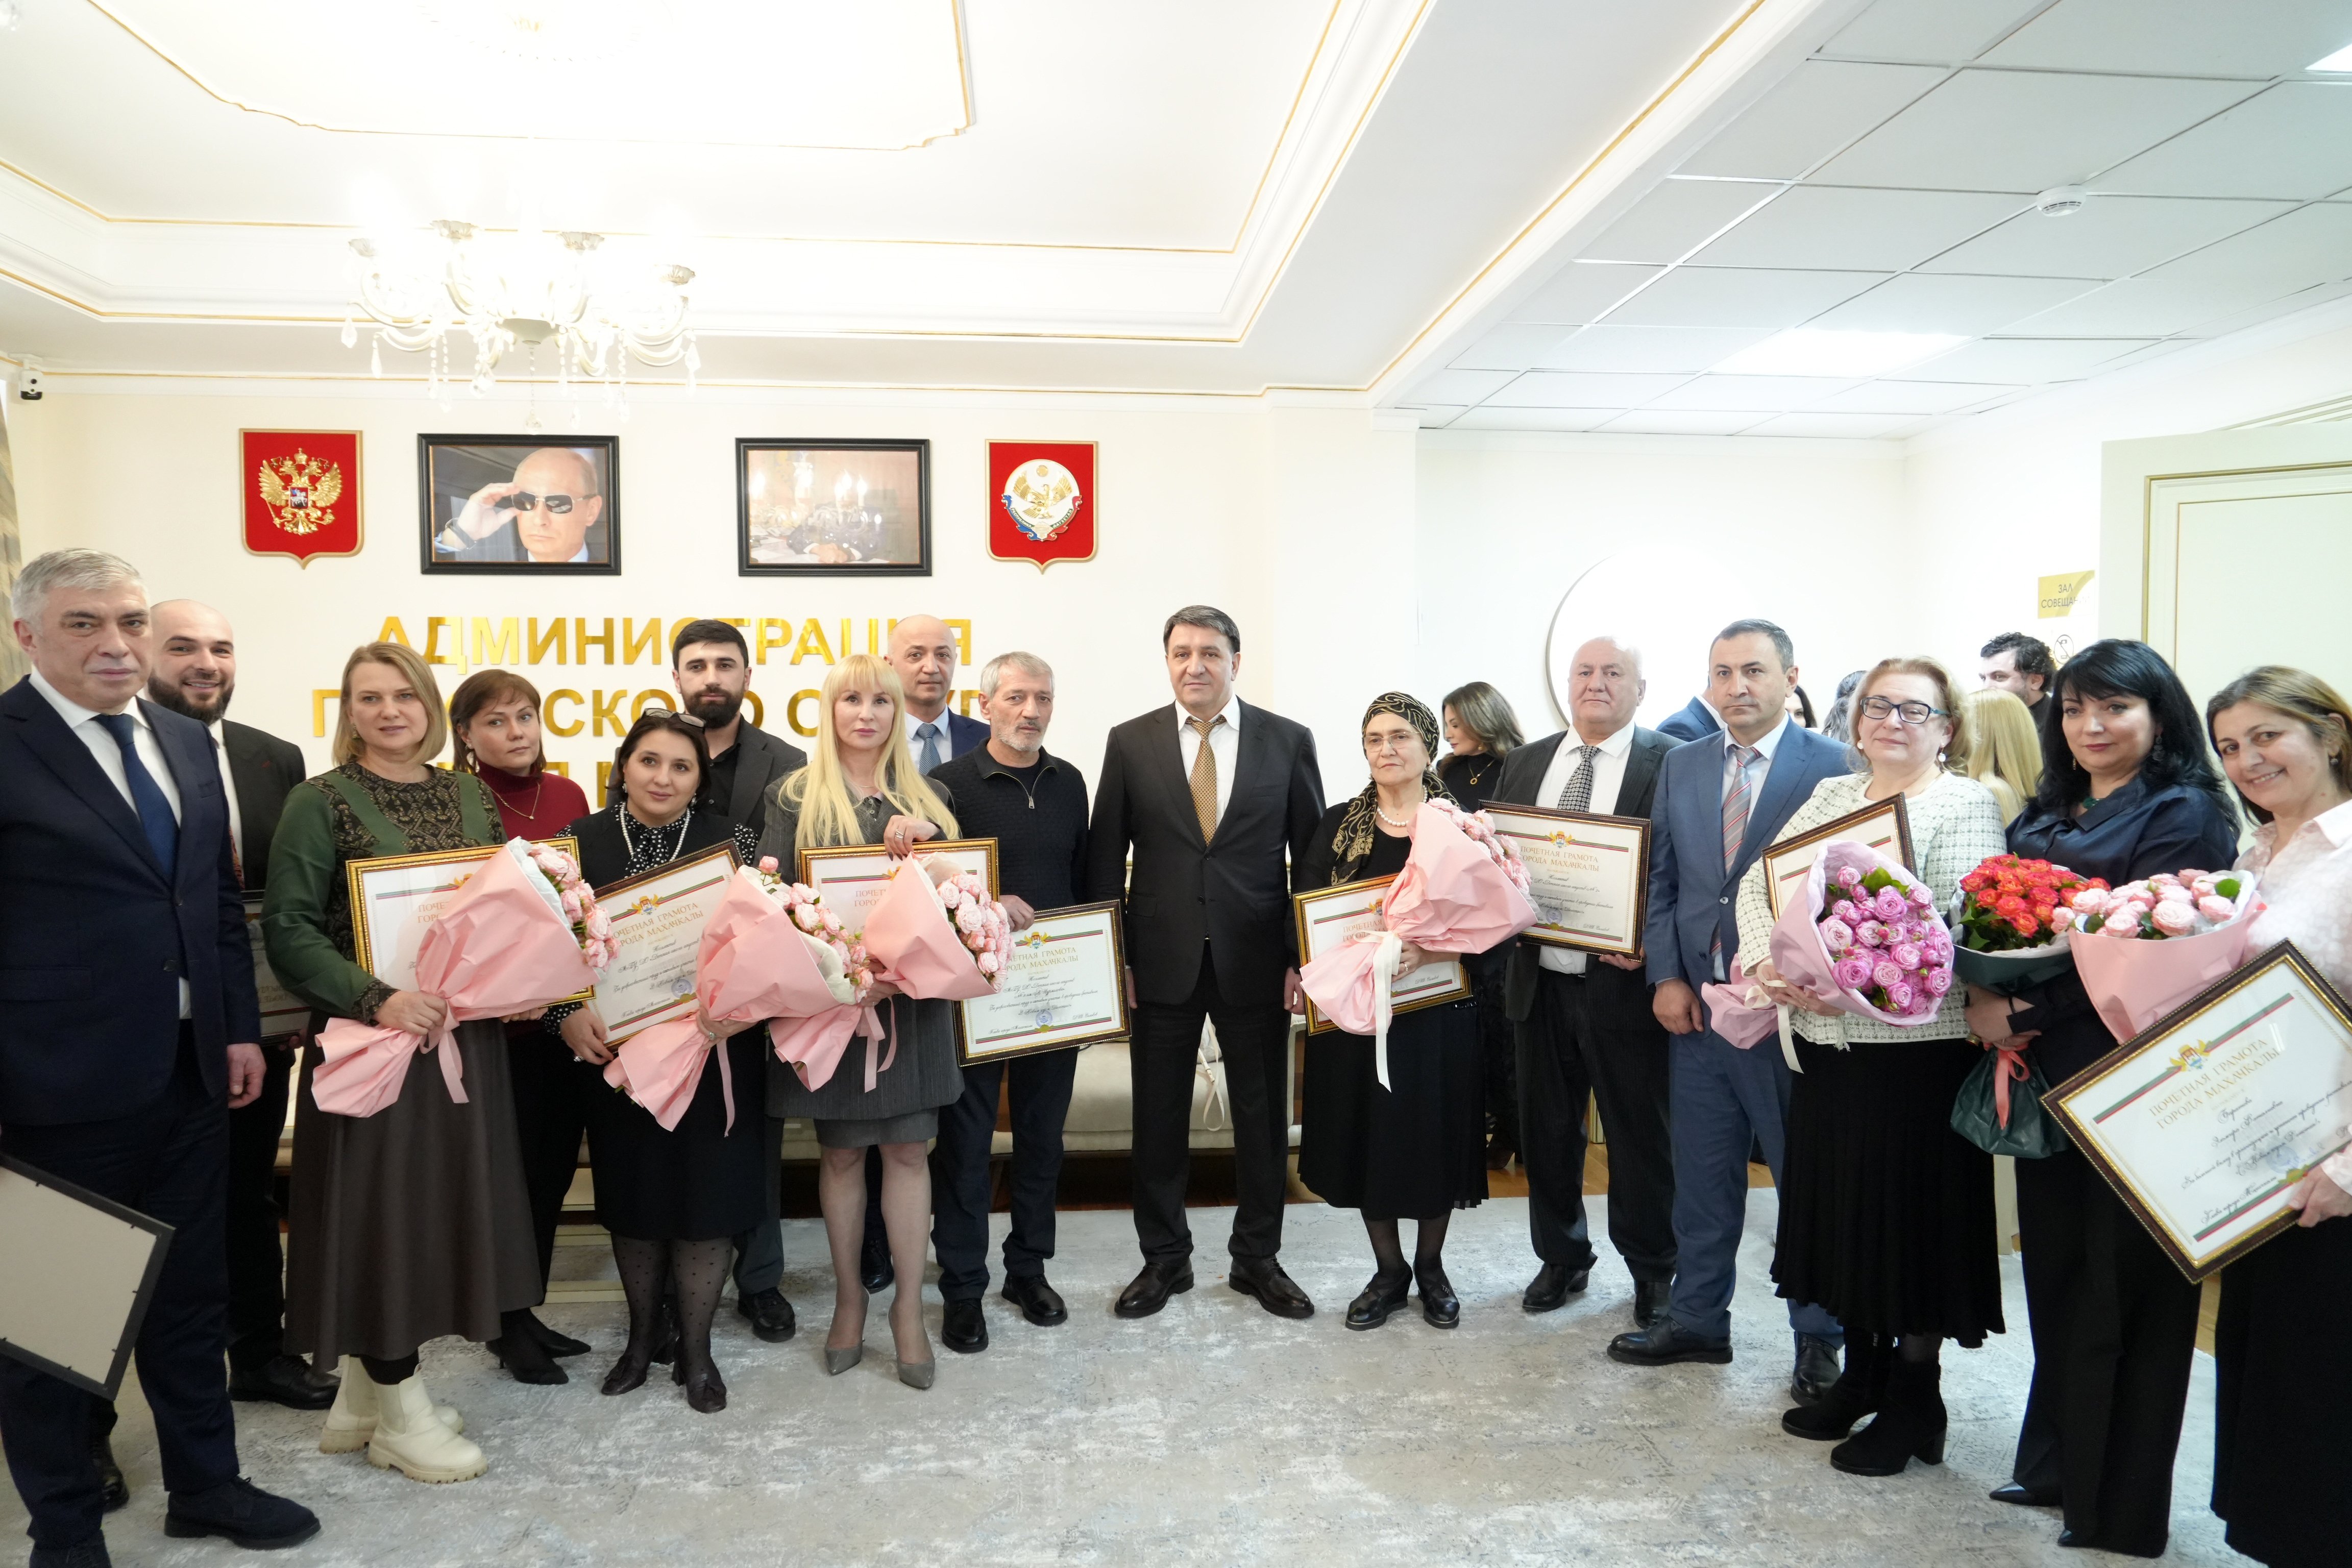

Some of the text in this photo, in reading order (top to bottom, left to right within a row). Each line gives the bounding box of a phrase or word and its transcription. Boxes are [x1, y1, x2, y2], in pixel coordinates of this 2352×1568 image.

[2058, 583, 2073, 593] ЗАЛ
[1521, 846, 1599, 864] ПОЧЕТНАЯ ГРАМОТА
[1522, 854, 1547, 866] ОРОДА
[1551, 859, 1600, 872] МАХАЧКАЛЫ
[657, 902, 699, 923] ГРАМОТА
[620, 934, 644, 947] РОДА
[647, 911, 704, 937] МАХАЧКАЛЫ
[1342, 919, 1383, 934] ПОЧЕТНАЯ
[1042, 947, 1076, 958] ГРАМОТА
[1006, 955, 1079, 972] РОДА МАХАЧКАЛЫ
[2148, 1073, 2212, 1118] ПОЧЕТНАЯ
[2212, 1038, 2269, 1077] ГРАМОТА
[2156, 1097, 2203, 1130] ГОРОДА
[2204, 1047, 2281, 1100] МАХАЧКАЛЫ
